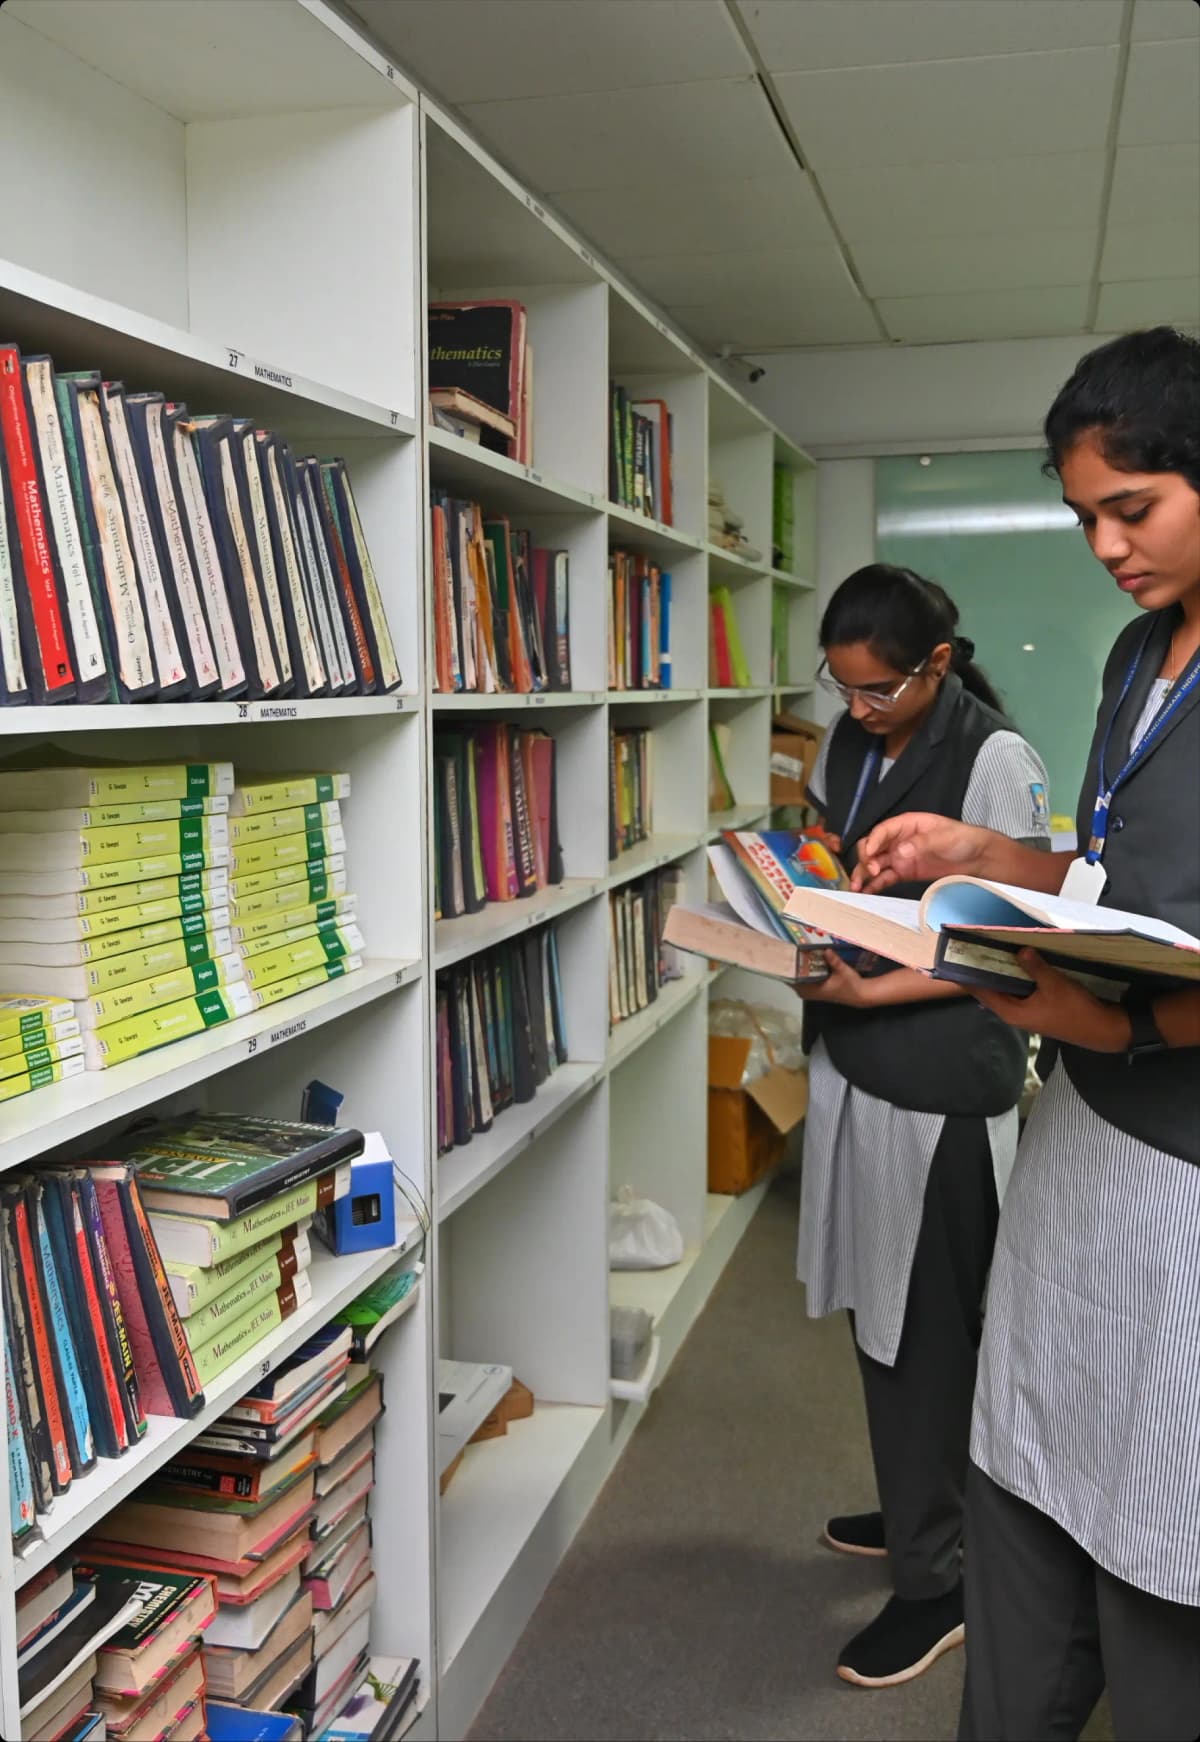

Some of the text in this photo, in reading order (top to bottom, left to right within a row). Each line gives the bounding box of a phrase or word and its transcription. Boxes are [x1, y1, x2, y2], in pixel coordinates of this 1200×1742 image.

[229, 353, 292, 388] 27 MATHEMATICS
[431, 345, 502, 361] thematics
[391, 412, 398, 424] 27
[27, 480, 50, 575] Mathematics
[52, 464, 76, 557] Mathematics
[106, 508, 130, 597] Mathematics
[139, 514, 158, 582] Mathematics
[168, 500, 190, 584] Mathematics
[196, 515, 216, 596] Mathematics
[238, 704, 297, 720] 28 MATHEMATICS
[515, 788, 531, 875] OBJECTIVE
[248, 1020, 307, 1053] 29 MATHEMATICS
[283, 1168, 310, 1185] CHEMISTRY
[243, 1209, 282, 1234] Mathematics
[286, 1200, 295, 1215] JEE
[42, 1244, 65, 1332] Mathematics
[210, 1270, 273, 1320] Mathematics JEE Main
[112, 1300, 133, 1368] JEE-MAIN
[162, 1286, 183, 1346] JEE-Main
[212, 1308, 273, 1359] Mathematics JEE Main
[260, 1360, 270, 1376] 30
[128, 1584, 178, 1629] CHEMISTRY
